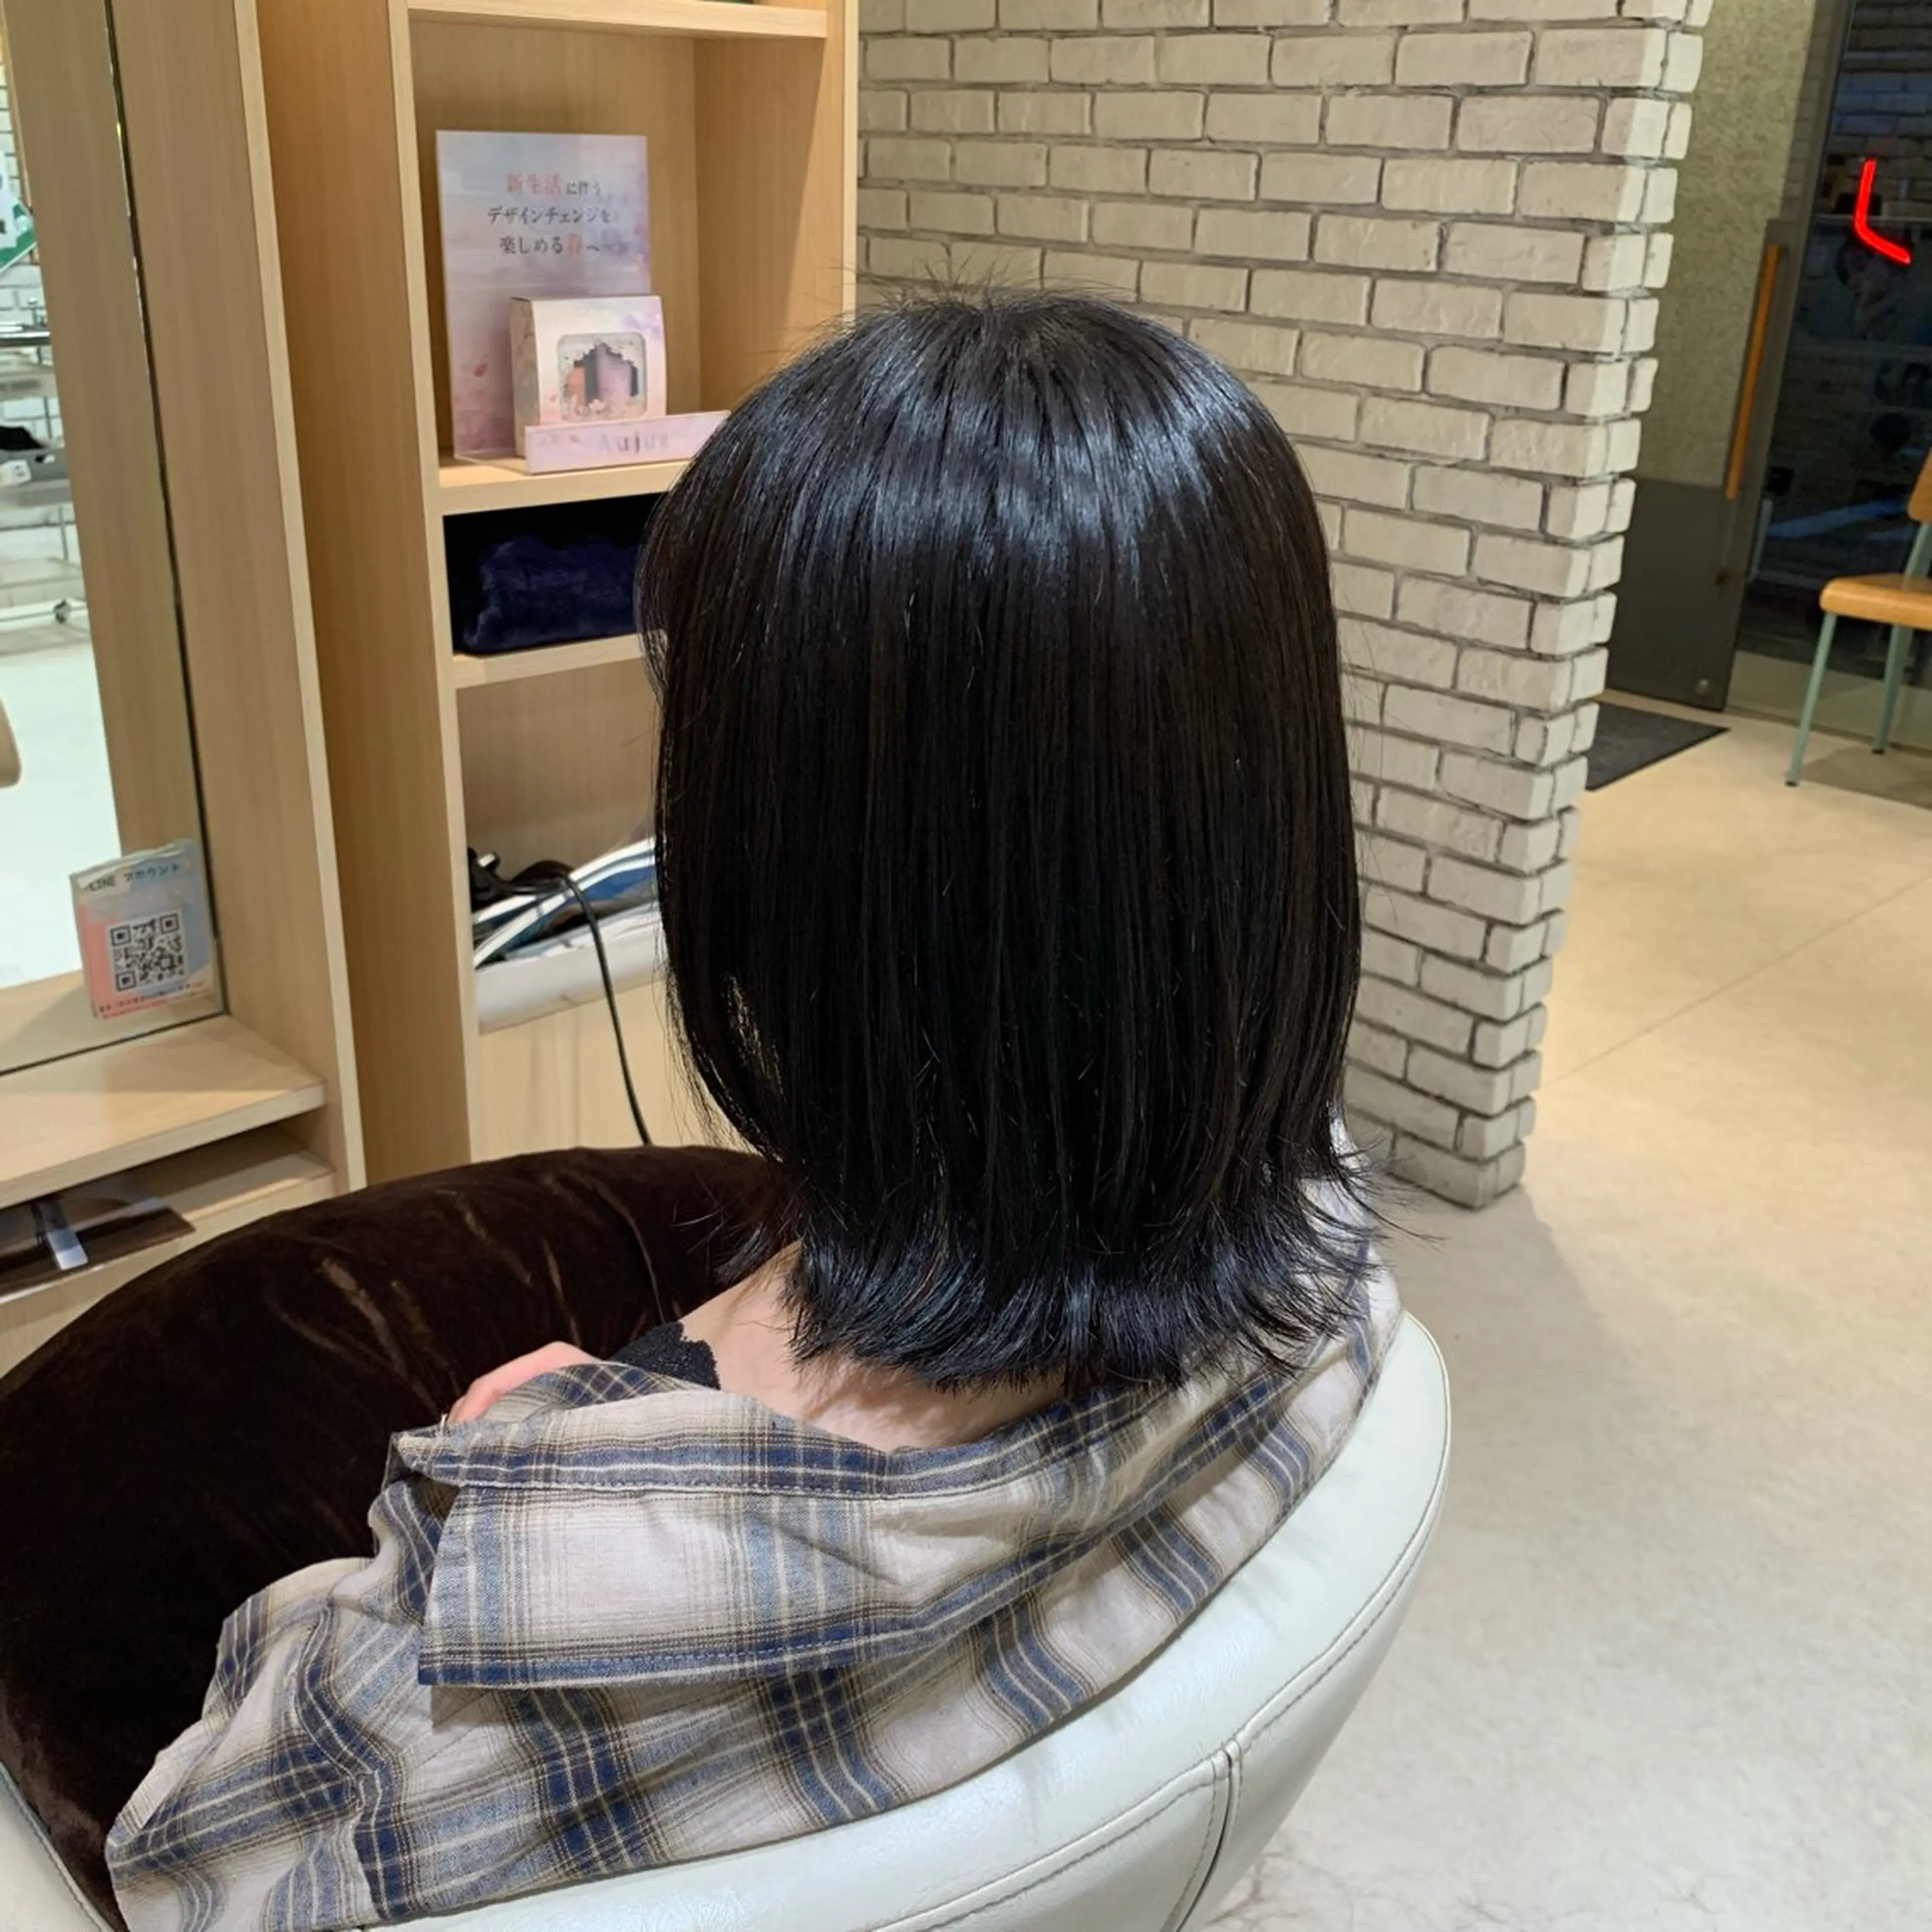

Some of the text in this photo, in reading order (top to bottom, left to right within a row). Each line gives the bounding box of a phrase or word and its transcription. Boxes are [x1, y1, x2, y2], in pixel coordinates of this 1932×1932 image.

[507, 173, 601, 197] 新生活に伴う
[487, 205, 611, 225] デザインチェンジを
[499, 234, 601, 255] 楽しめる春へ
